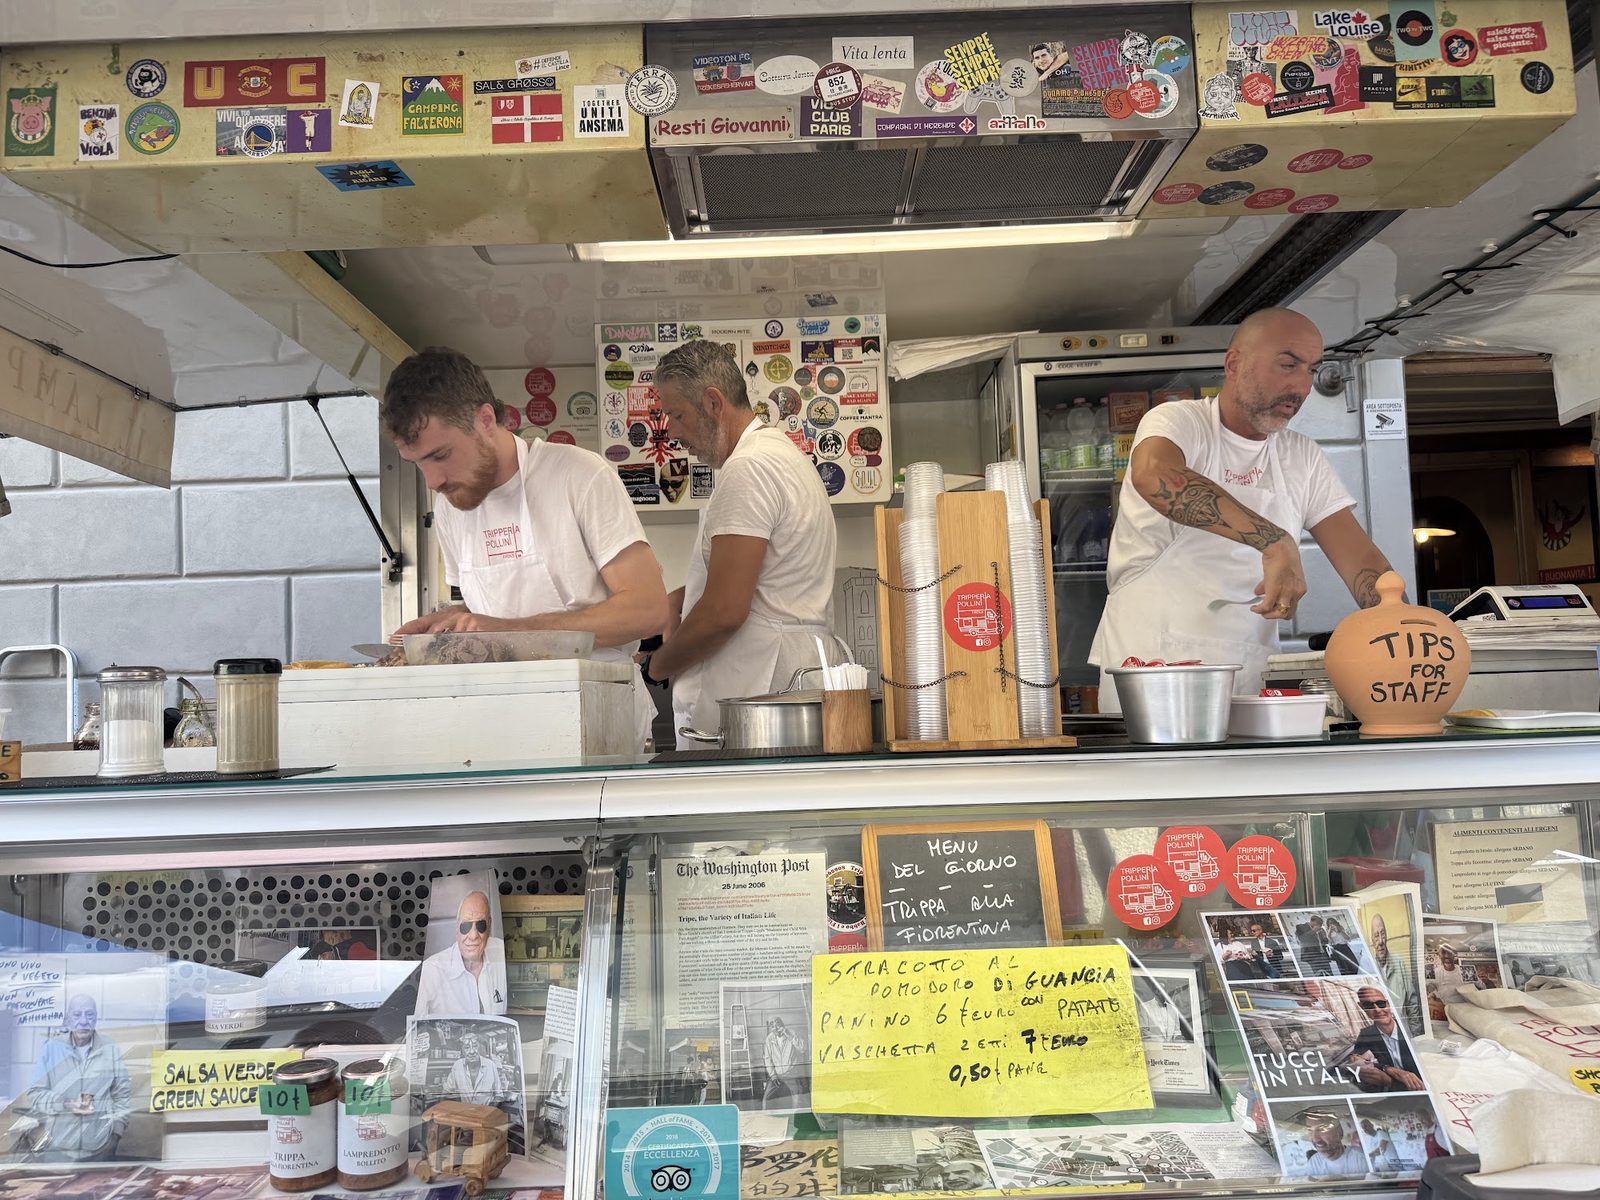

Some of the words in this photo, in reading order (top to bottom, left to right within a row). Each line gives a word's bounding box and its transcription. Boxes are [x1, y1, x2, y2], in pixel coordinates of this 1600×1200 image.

[1315, 12, 1351, 26] Lake
[1331, 21, 1380, 37] Louise
[1486, 34, 1507, 42] salsa
[841, 45, 868, 60] Vita
[872, 44, 907, 60] lenta
[944, 31, 994, 63] SEMPRE
[695, 54, 737, 65] VIDEOTON
[739, 53, 751, 61] FC
[951, 46, 1000, 78] SEMPRE
[1077, 52, 1123, 76] SEMPR
[194, 67, 225, 100] U
[287, 63, 317, 96] C
[475, 80, 504, 90] SAL&
[630, 69, 667, 87] TERRA
[828, 75, 846, 87] 852
[80, 105, 117, 121] BENZINA
[408, 103, 459, 114] CAMPING
[581, 107, 622, 119] UNITI
[217, 111, 235, 123] VIVI
[235, 114, 287, 128] QUARTIERE
[403, 115, 463, 130] FALTERONA
[812, 111, 850, 122] CLUB
[579, 118, 624, 133] ANSEMA
[658, 119, 705, 136] Resti
[711, 115, 787, 135] Giovanni
[810, 123, 852, 135] PARIS
[877, 123, 912, 131] COMPAGNI
[80, 141, 114, 156] VIOLA
[243, 146, 276, 158] WARRIORS
[352, 176, 388, 184] RICARD
[856, 470, 877, 487] SOUL
[483, 525, 521, 539] TRIPPERIA
[485, 537, 511, 549] POLLINI
[1369, 632, 1456, 662] TIPS
[1410, 663, 1446, 680] FOR
[1370, 681, 1451, 704] STAFF
[1167, 831, 1204, 841] TRIPPERIA
[1453, 829, 1482, 837] ALIMENTI
[1483, 827, 1522, 835] CONTENENTI
[1524, 825, 1558, 833] ALLERGENI
[927, 838, 978, 857] MENU
[1167, 841, 1195, 849] POLLINI
[1237, 845, 1275, 854] TRIPPERIA
[1237, 854, 1265, 862] POLLINI
[676, 863, 699, 878] The
[702, 859, 778, 878] Washington
[781, 858, 810, 876] Post
[892, 862, 925, 880] DEL
[1120, 865, 1158, 875] TRIPPERIA
[1121, 874, 1149, 883] POLLINI
[732, 882, 747, 890] June
[709, 914, 732, 922] Variety
[741, 912, 763, 920] Italian
[20, 960, 42, 970] VIVO
[829, 959, 965, 985] STRACOTTO
[988, 955, 1019, 971] AL
[22, 970, 60, 981] VEGETO
[870, 979, 974, 999] POMODORO
[821, 1011, 911, 1033] PANINO
[935, 1003, 948, 1025] 6
[1057, 997, 1121, 1020] PATATE
[222, 1021, 244, 1030] VERDE
[819, 1042, 936, 1064] VASCHETTA
[960, 1038, 970, 1051] 2
[1021, 1029, 1036, 1054] 7
[1254, 1050, 1326, 1070] TUCCI
[164, 1062, 220, 1085] SALSA
[224, 1061, 276, 1082] VERDE
[1007, 1061, 1049, 1079] PANE
[1260, 1068, 1288, 1088] IN
[1293, 1066, 1363, 1086] ITALY
[152, 1088, 205, 1111] GREEN
[210, 1086, 259, 1106] SAUCE
[649, 1117, 668, 1128] HALL
[675, 1116, 694, 1128] FAME
[630, 1130, 646, 1146] 2015
[699, 1127, 714, 1144] 2016
[343, 1143, 401, 1159] LAMPREDOTTO
[647, 1143, 690, 1151] CERTIFICATO
[274, 1152, 306, 1161] TRIPPA
[643, 1149, 700, 1160] ECCELLENZA
[279, 1160, 319, 1170] FIORENTINA
[356, 1157, 387, 1168] BOLLITO
[623, 1153, 631, 1173] 2014
[711, 1152, 720, 1171] 2017
